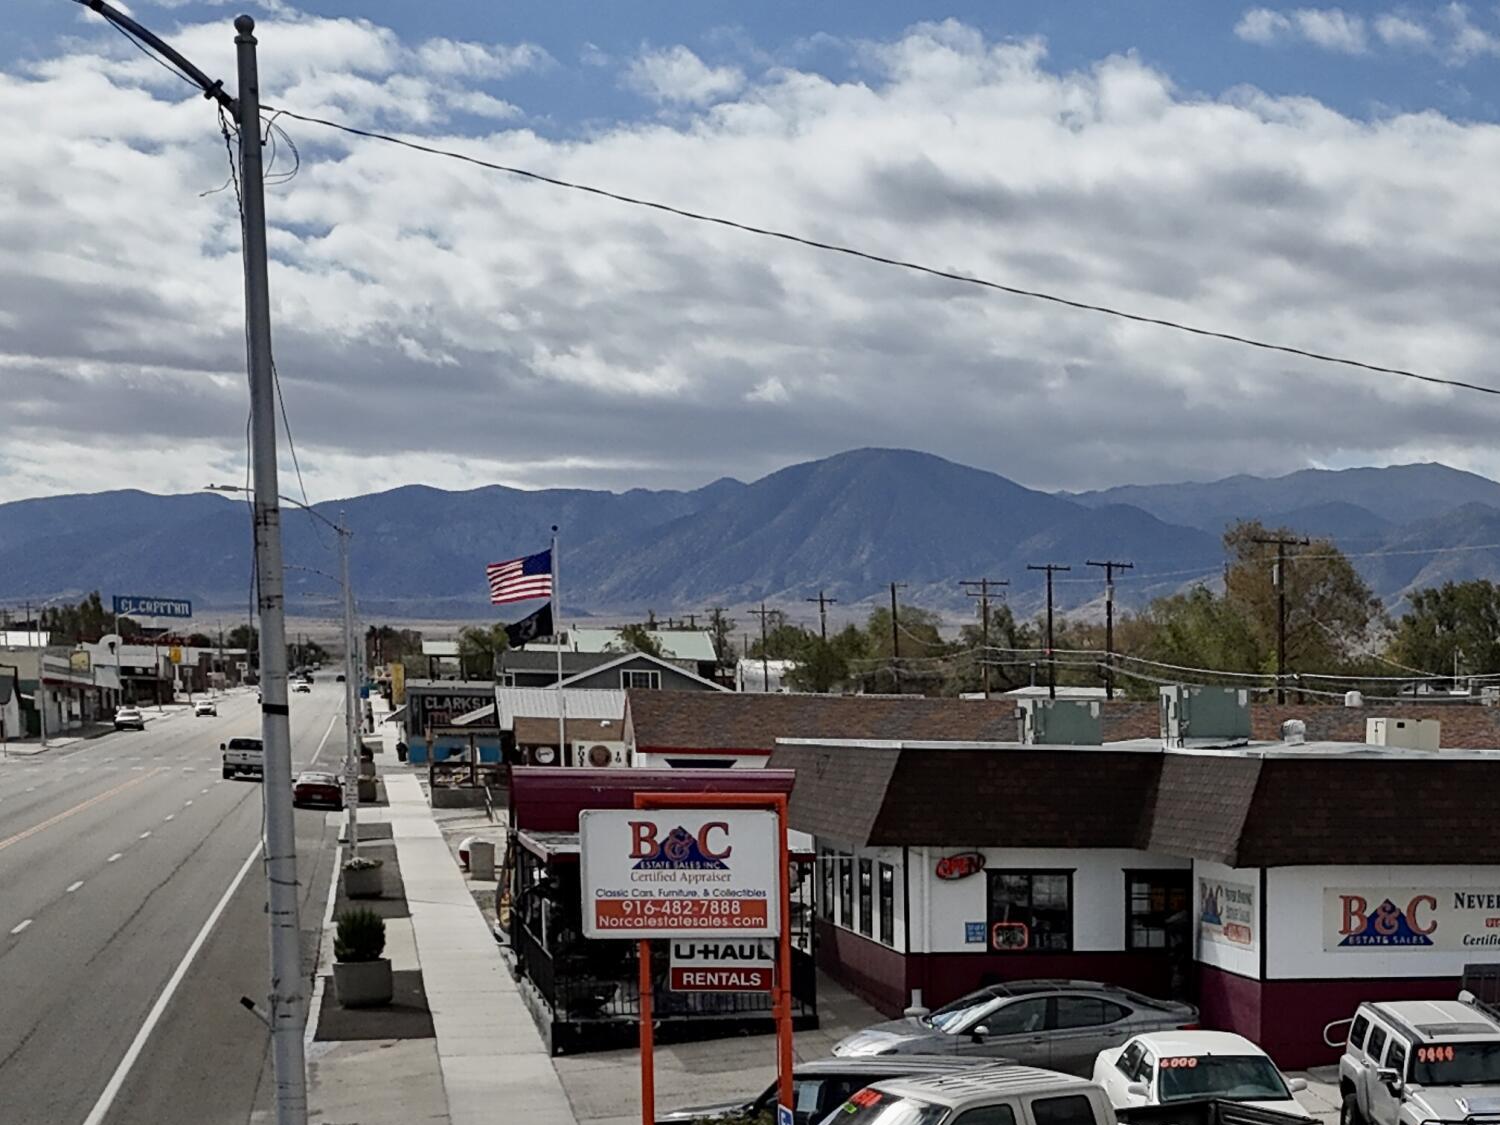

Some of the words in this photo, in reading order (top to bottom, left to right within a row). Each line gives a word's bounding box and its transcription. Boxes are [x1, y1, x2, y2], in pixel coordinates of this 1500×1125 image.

[627, 821, 732, 860] B&C
[640, 861, 671, 869] ESTATE
[674, 861, 701, 869] SALES
[630, 871, 676, 882] Certified
[680, 872, 731, 884] Appraiser
[595, 888, 629, 897] Classic
[703, 889, 709, 897] &
[712, 888, 766, 897] Collectibles
[622, 901, 741, 915] 916-482-7888
[599, 915, 764, 927] Norcalestatesales.com
[1338, 895, 1437, 935] B&C
[1348, 935, 1389, 944] ESTATE
[1393, 935, 1424, 944] SALES
[674, 944, 771, 960] U-HAUL
[683, 972, 761, 986] RENTALS
